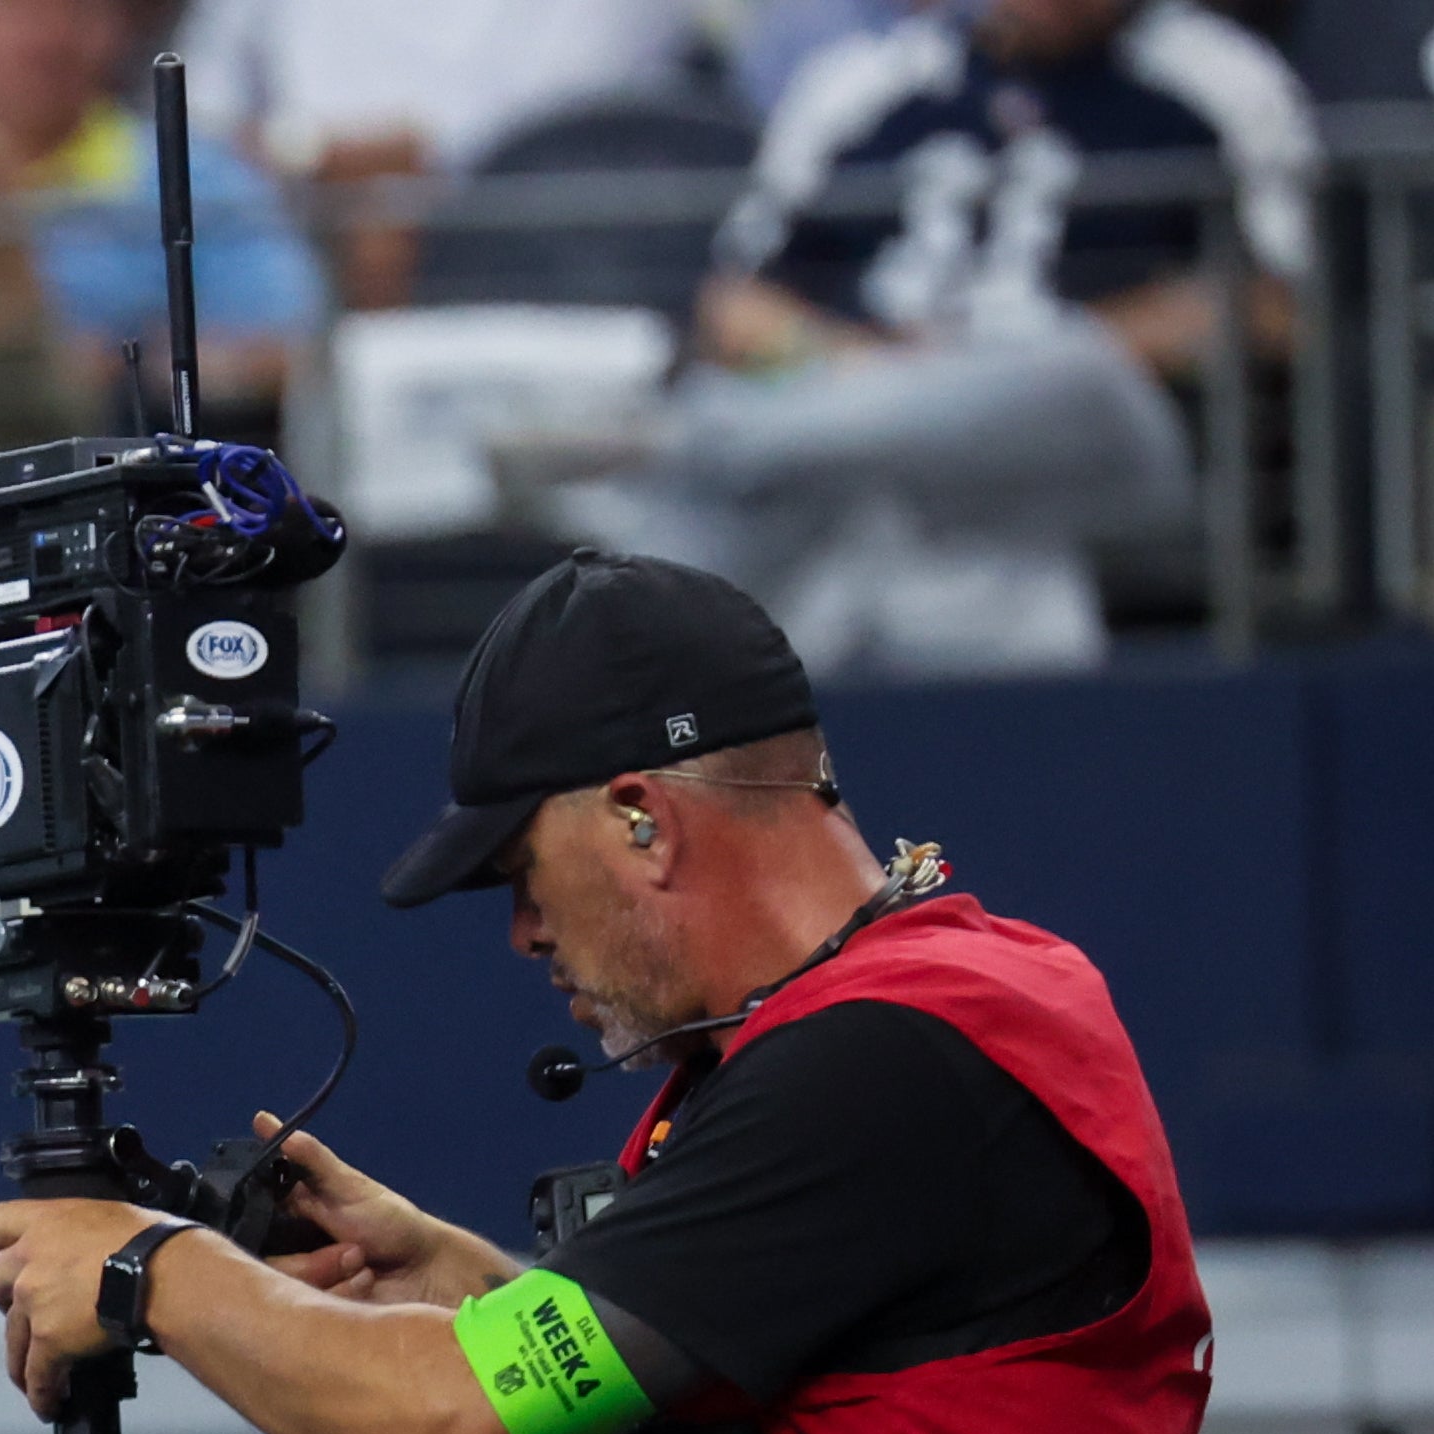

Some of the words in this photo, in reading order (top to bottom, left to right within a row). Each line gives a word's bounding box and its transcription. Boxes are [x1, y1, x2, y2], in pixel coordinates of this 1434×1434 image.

[210, 635, 244, 653] FOX
[576, 1315, 598, 1346] DAL
[533, 1296, 590, 1381] WEEK
[575, 1379, 602, 1398] 4
